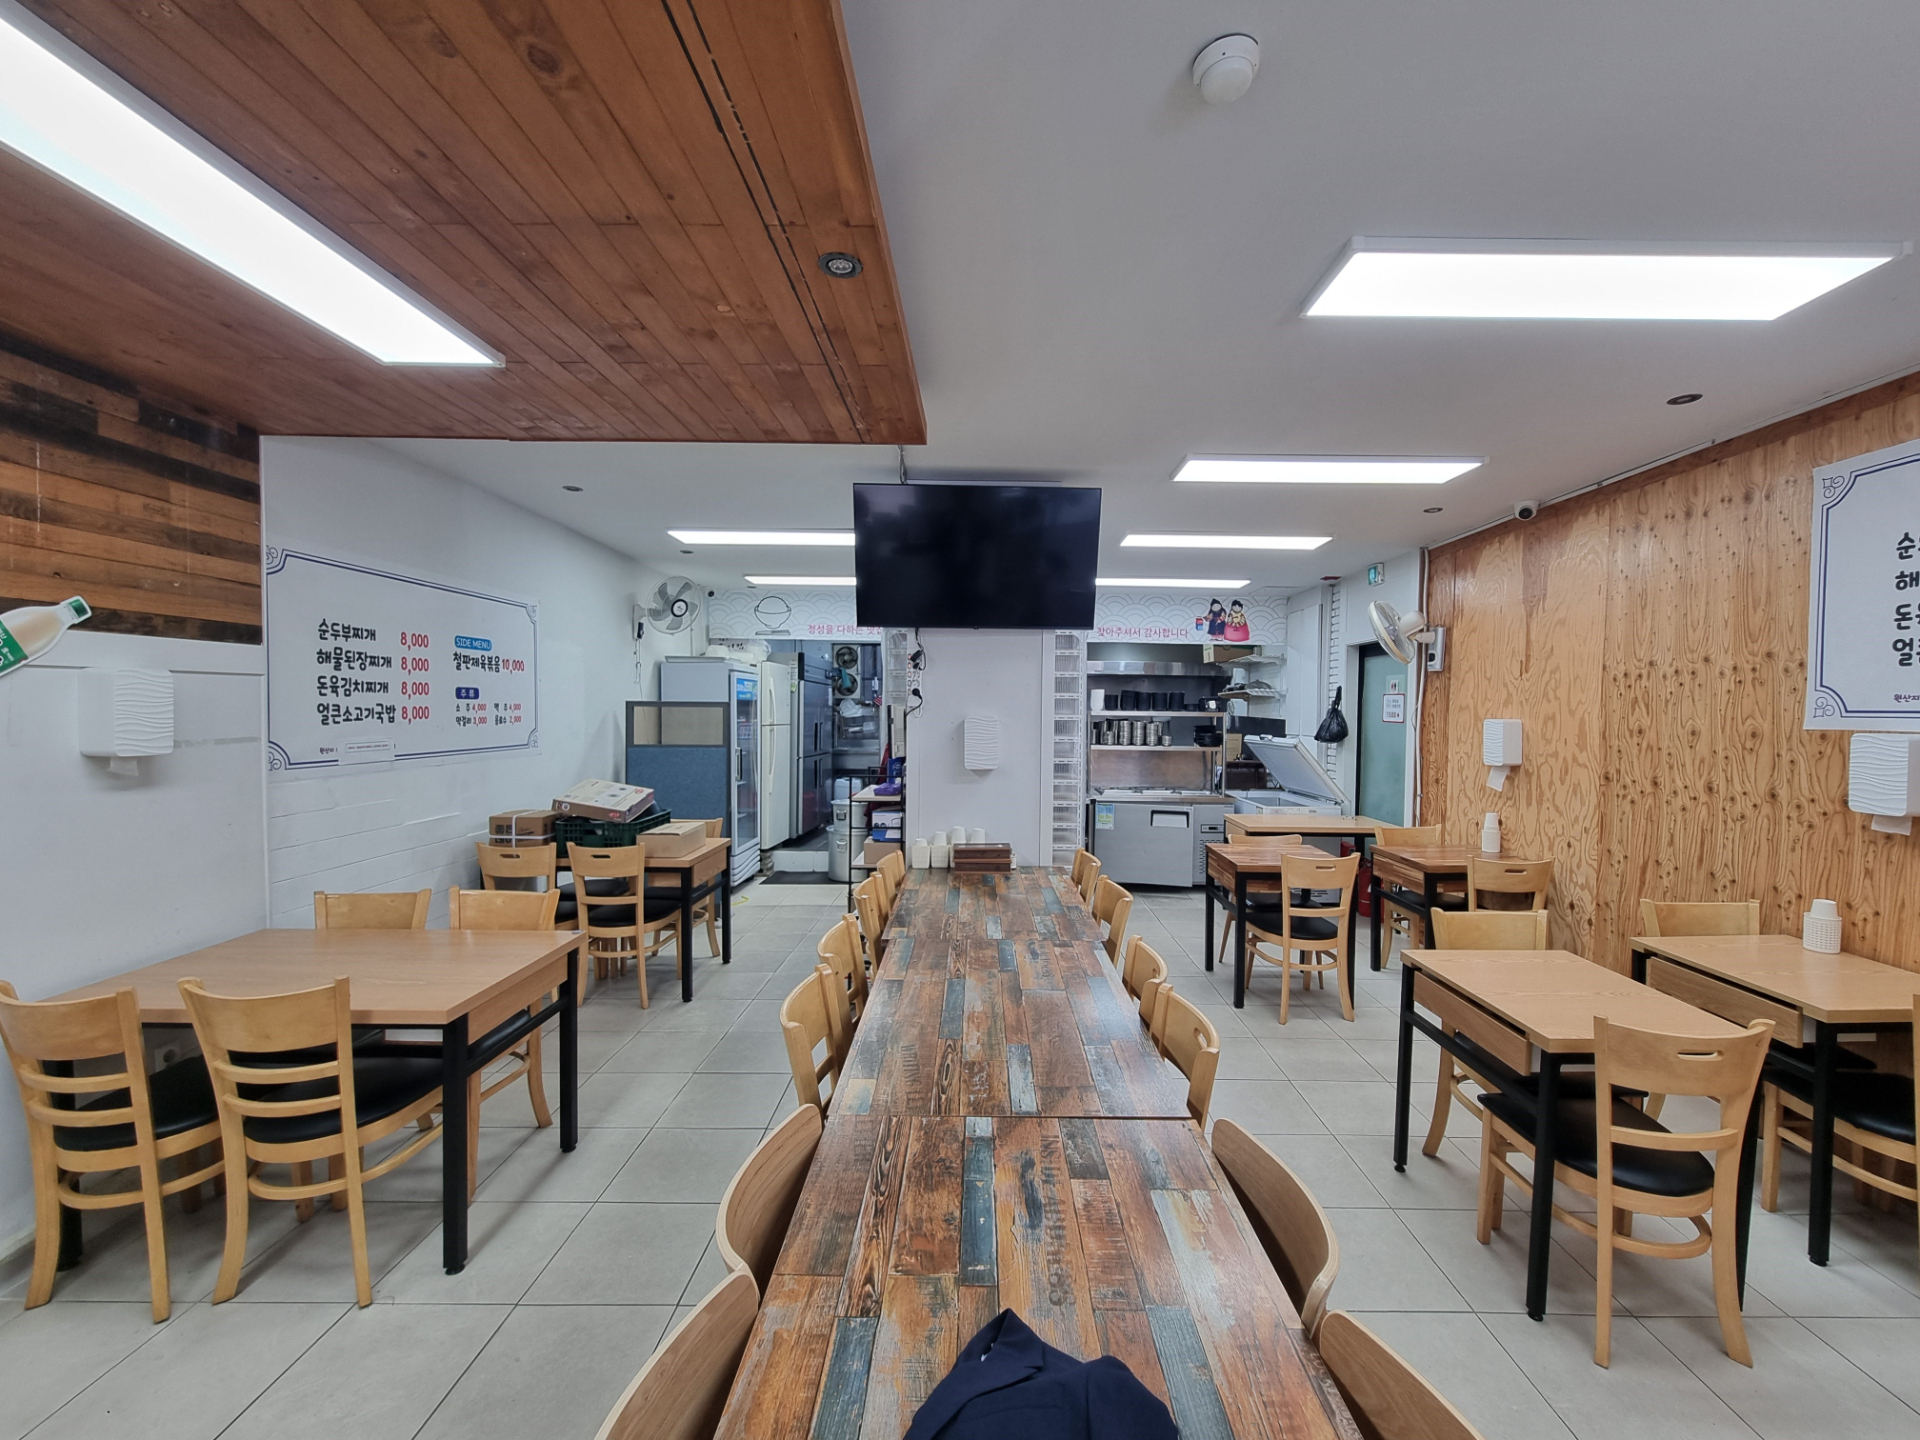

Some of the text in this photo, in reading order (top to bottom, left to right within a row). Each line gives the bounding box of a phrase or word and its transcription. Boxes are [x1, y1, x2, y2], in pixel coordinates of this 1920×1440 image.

[1896, 531, 1920, 560] 순
[1893, 602, 1920, 630] 돈
[318, 618, 429, 651] 순두부찌개 8,000
[808, 624, 834, 635] 정성을
[1144, 627, 1189, 639] 감사합니다
[456, 637, 491, 650] SIDE MENU
[1892, 637, 1920, 667] 얼
[316, 646, 429, 676] 해물된장찌개 8,000
[453, 651, 525, 675] 철판제육볶음 10,000
[317, 675, 430, 701] 돈육김치찌개 8,000
[317, 703, 430, 726] 얼큰소고기국밥 8,000
[472, 703, 487, 714] 4,000
[509, 703, 522, 713] 4,000
[456, 715, 487, 728] 막걸리 3,000
[509, 715, 522, 725] 2,000
